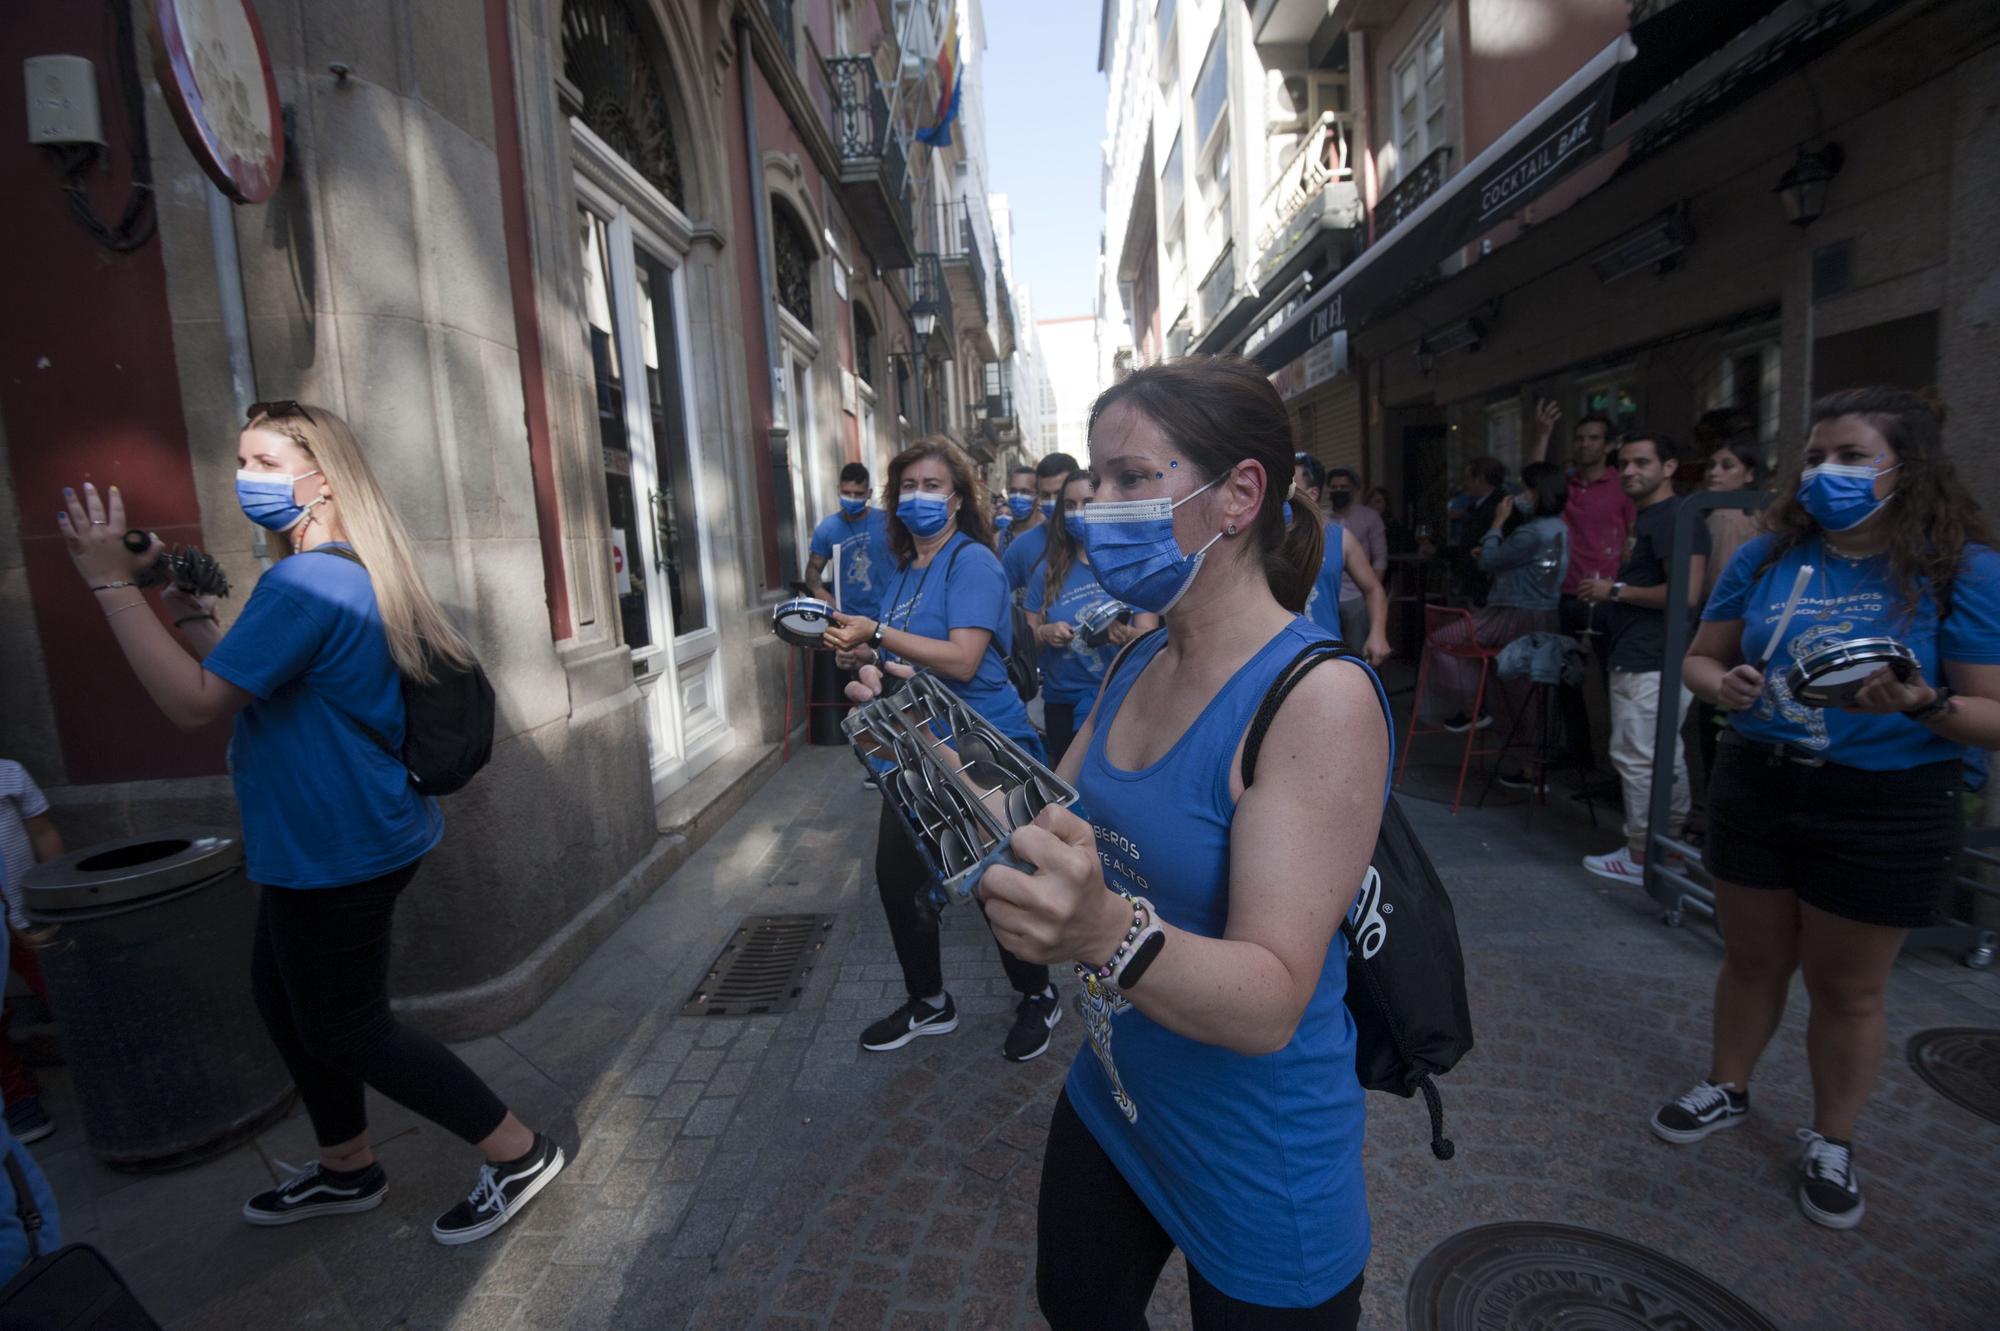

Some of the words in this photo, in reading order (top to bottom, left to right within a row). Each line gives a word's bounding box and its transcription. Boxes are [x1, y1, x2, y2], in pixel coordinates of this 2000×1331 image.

[1481, 147, 1552, 210] COCKTAIL
[1557, 114, 1590, 157] BAR
[1770, 592, 1883, 610] KIOMBEROS
[1093, 825, 1141, 860] BEROS
[1113, 859, 1149, 889] ALTO
